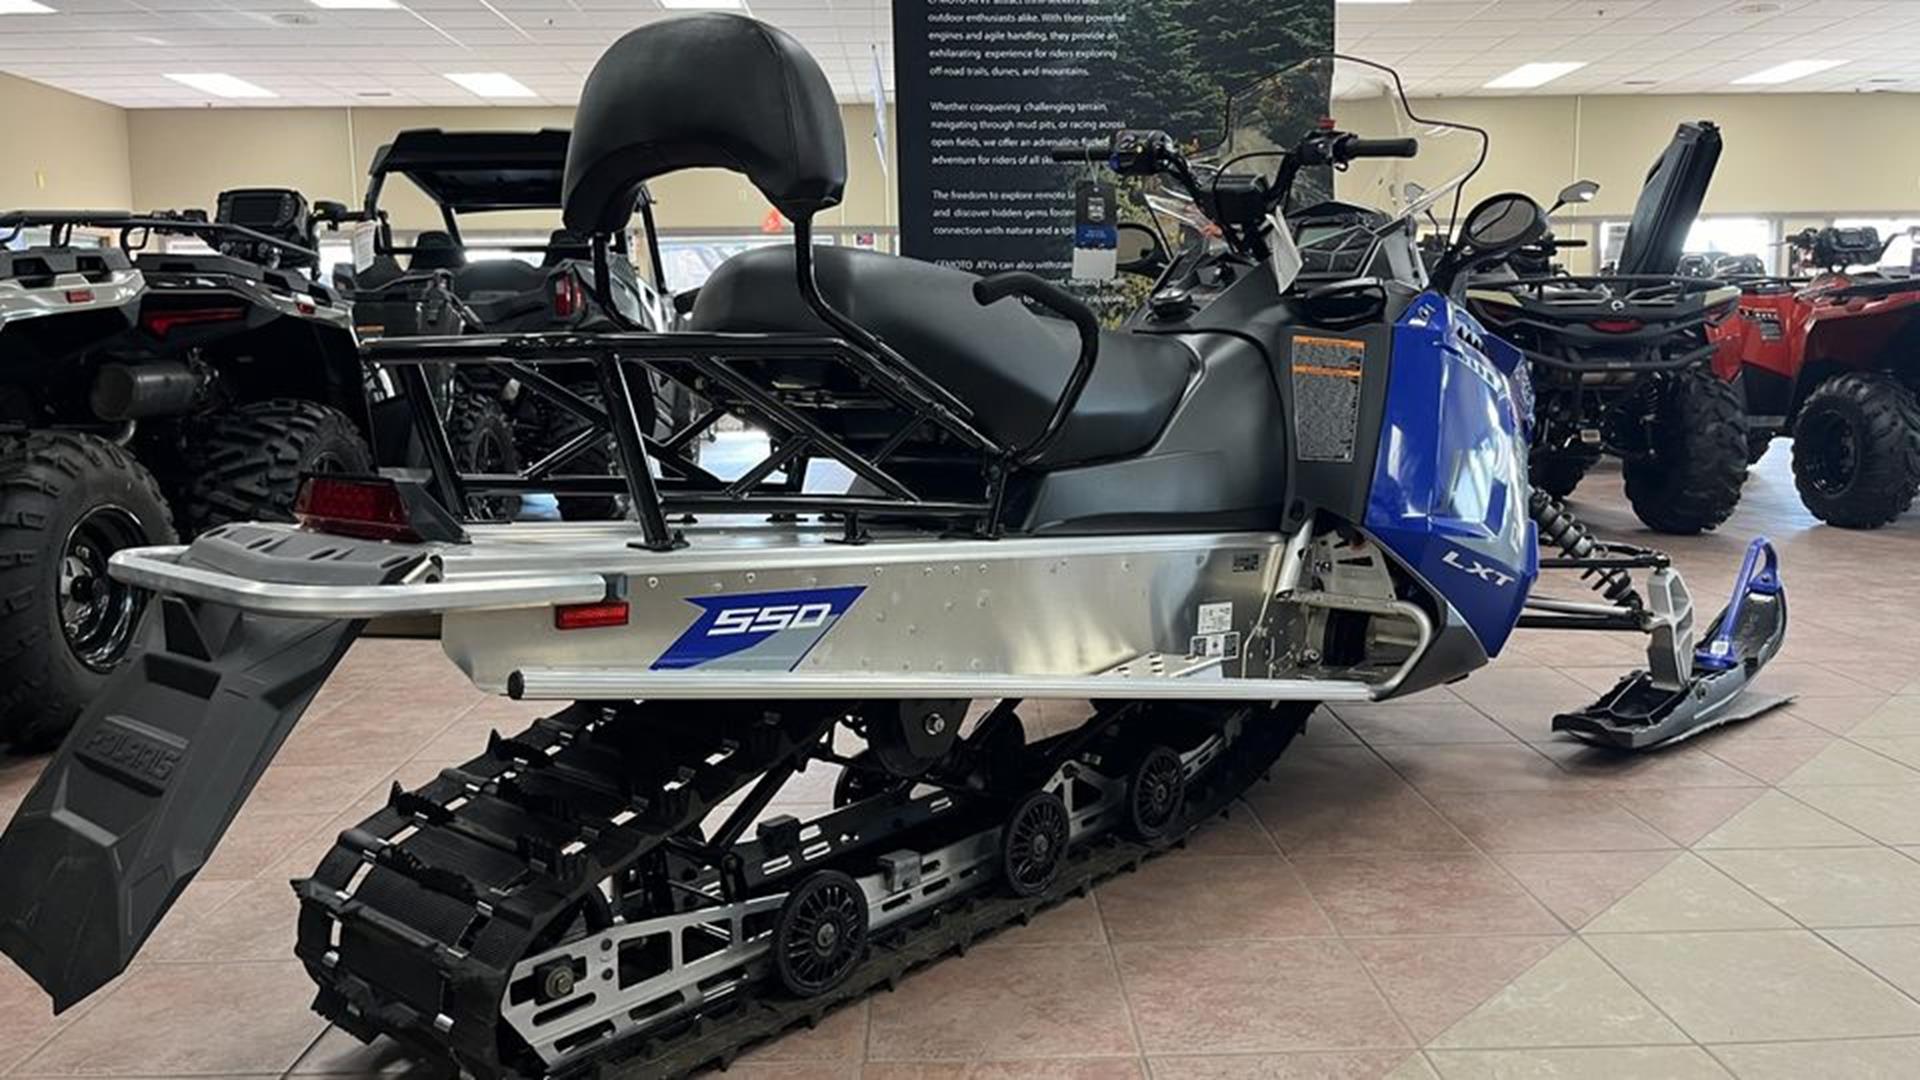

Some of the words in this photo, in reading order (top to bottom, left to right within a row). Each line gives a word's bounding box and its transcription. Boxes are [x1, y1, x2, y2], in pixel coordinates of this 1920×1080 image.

[928, 13, 963, 23] outdoor
[966, 13, 1016, 23] enthusiasts
[1041, 13, 1062, 23] With
[1063, 13, 1084, 23] their
[1085, 13, 1126, 24] powerful
[928, 31, 963, 42] engines
[965, 31, 982, 41] and
[984, 31, 1005, 42] agile
[1049, 31, 1070, 42] they
[1071, 31, 1105, 42] provide
[1106, 33, 1119, 41] an
[928, 48, 981, 60] exhilarating
[984, 49, 1032, 60] experience
[1034, 48, 1046, 59] for
[1048, 48, 1074, 59] riders
[1075, 49, 1118, 61] exploring
[929, 66, 965, 77] off-road
[1022, 66, 1040, 77] and
[929, 101, 968, 112] Whether
[969, 103, 1021, 114] conquering
[1023, 102, 1076, 113] challenging
[931, 120, 978, 131] navigating
[979, 120, 1015, 131] through
[1016, 120, 1038, 130] mud
[1058, 122, 1068, 130] or
[1069, 121, 1097, 131] racing
[1098, 122, 1127, 130] across
[930, 138, 955, 148] open
[982, 139, 997, 147] we
[998, 137, 1019, 148] offer
[1020, 139, 1032, 147] an
[1033, 137, 1079, 148] adrenaline
[931, 155, 976, 166] adventure
[978, 155, 990, 165] for
[991, 155, 1017, 166] riders
[1018, 155, 1028, 165] of
[1029, 155, 1041, 165] all
[932, 189, 949, 200] The
[950, 189, 988, 200] freedom
[989, 190, 999, 200] to
[1000, 190, 1033, 201] explore
[1034, 191, 1066, 200] remote
[932, 207, 951, 218] and
[953, 207, 990, 218] discover
[991, 207, 1022, 218] hidden
[1023, 209, 1048, 219] gems
[932, 226, 983, 236] connection
[984, 226, 1004, 236] with
[1005, 227, 1034, 236] nature
[1035, 226, 1051, 236] and
[975, 260, 997, 271] ATVs
[998, 262, 1014, 271] can
[1016, 260, 1034, 271] also
[1441, 551, 1516, 587] LXT
[707, 603, 832, 636] 550
